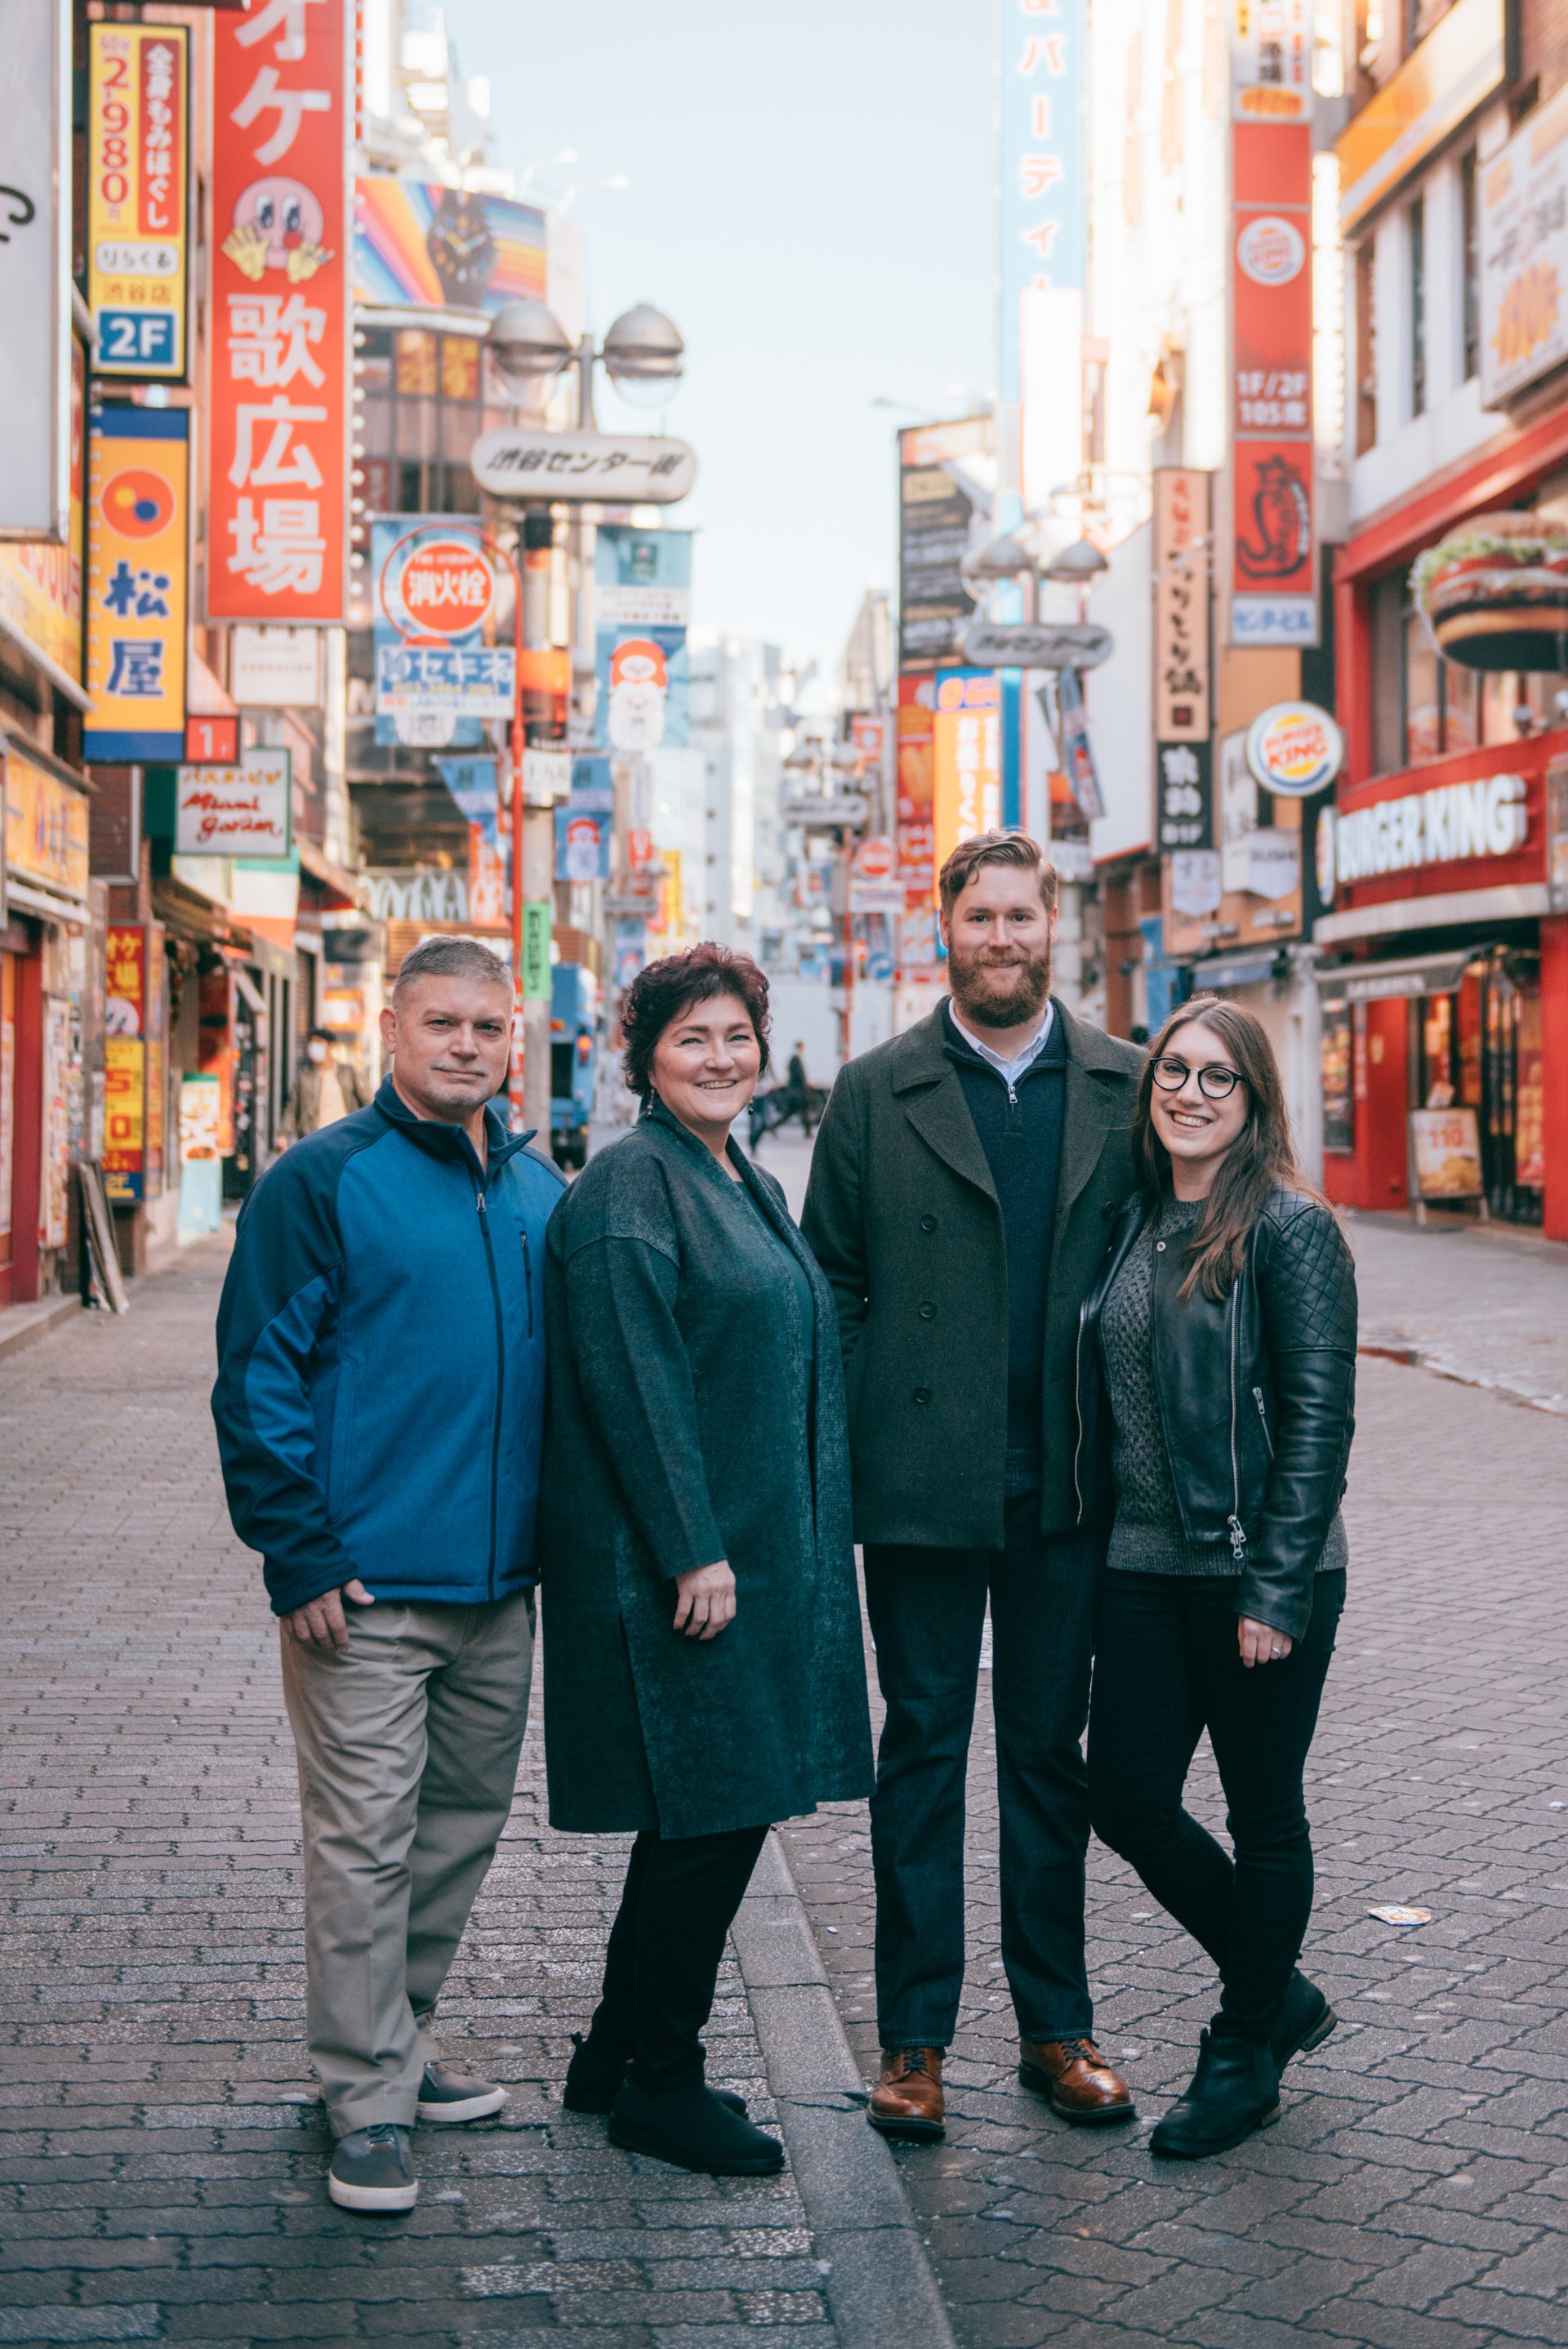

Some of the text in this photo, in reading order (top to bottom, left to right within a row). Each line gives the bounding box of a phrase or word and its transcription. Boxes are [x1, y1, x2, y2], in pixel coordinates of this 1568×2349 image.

[109, 316, 167, 358] 2F
[408, 568, 488, 607] 消火栓
[103, 559, 172, 698] 松屋
[1267, 734, 1328, 773] KING
[182, 791, 260, 813] Miami
[197, 815, 283, 845] Garden
[1337, 794, 1423, 883] BURGER
[1423, 773, 1529, 864] KING
